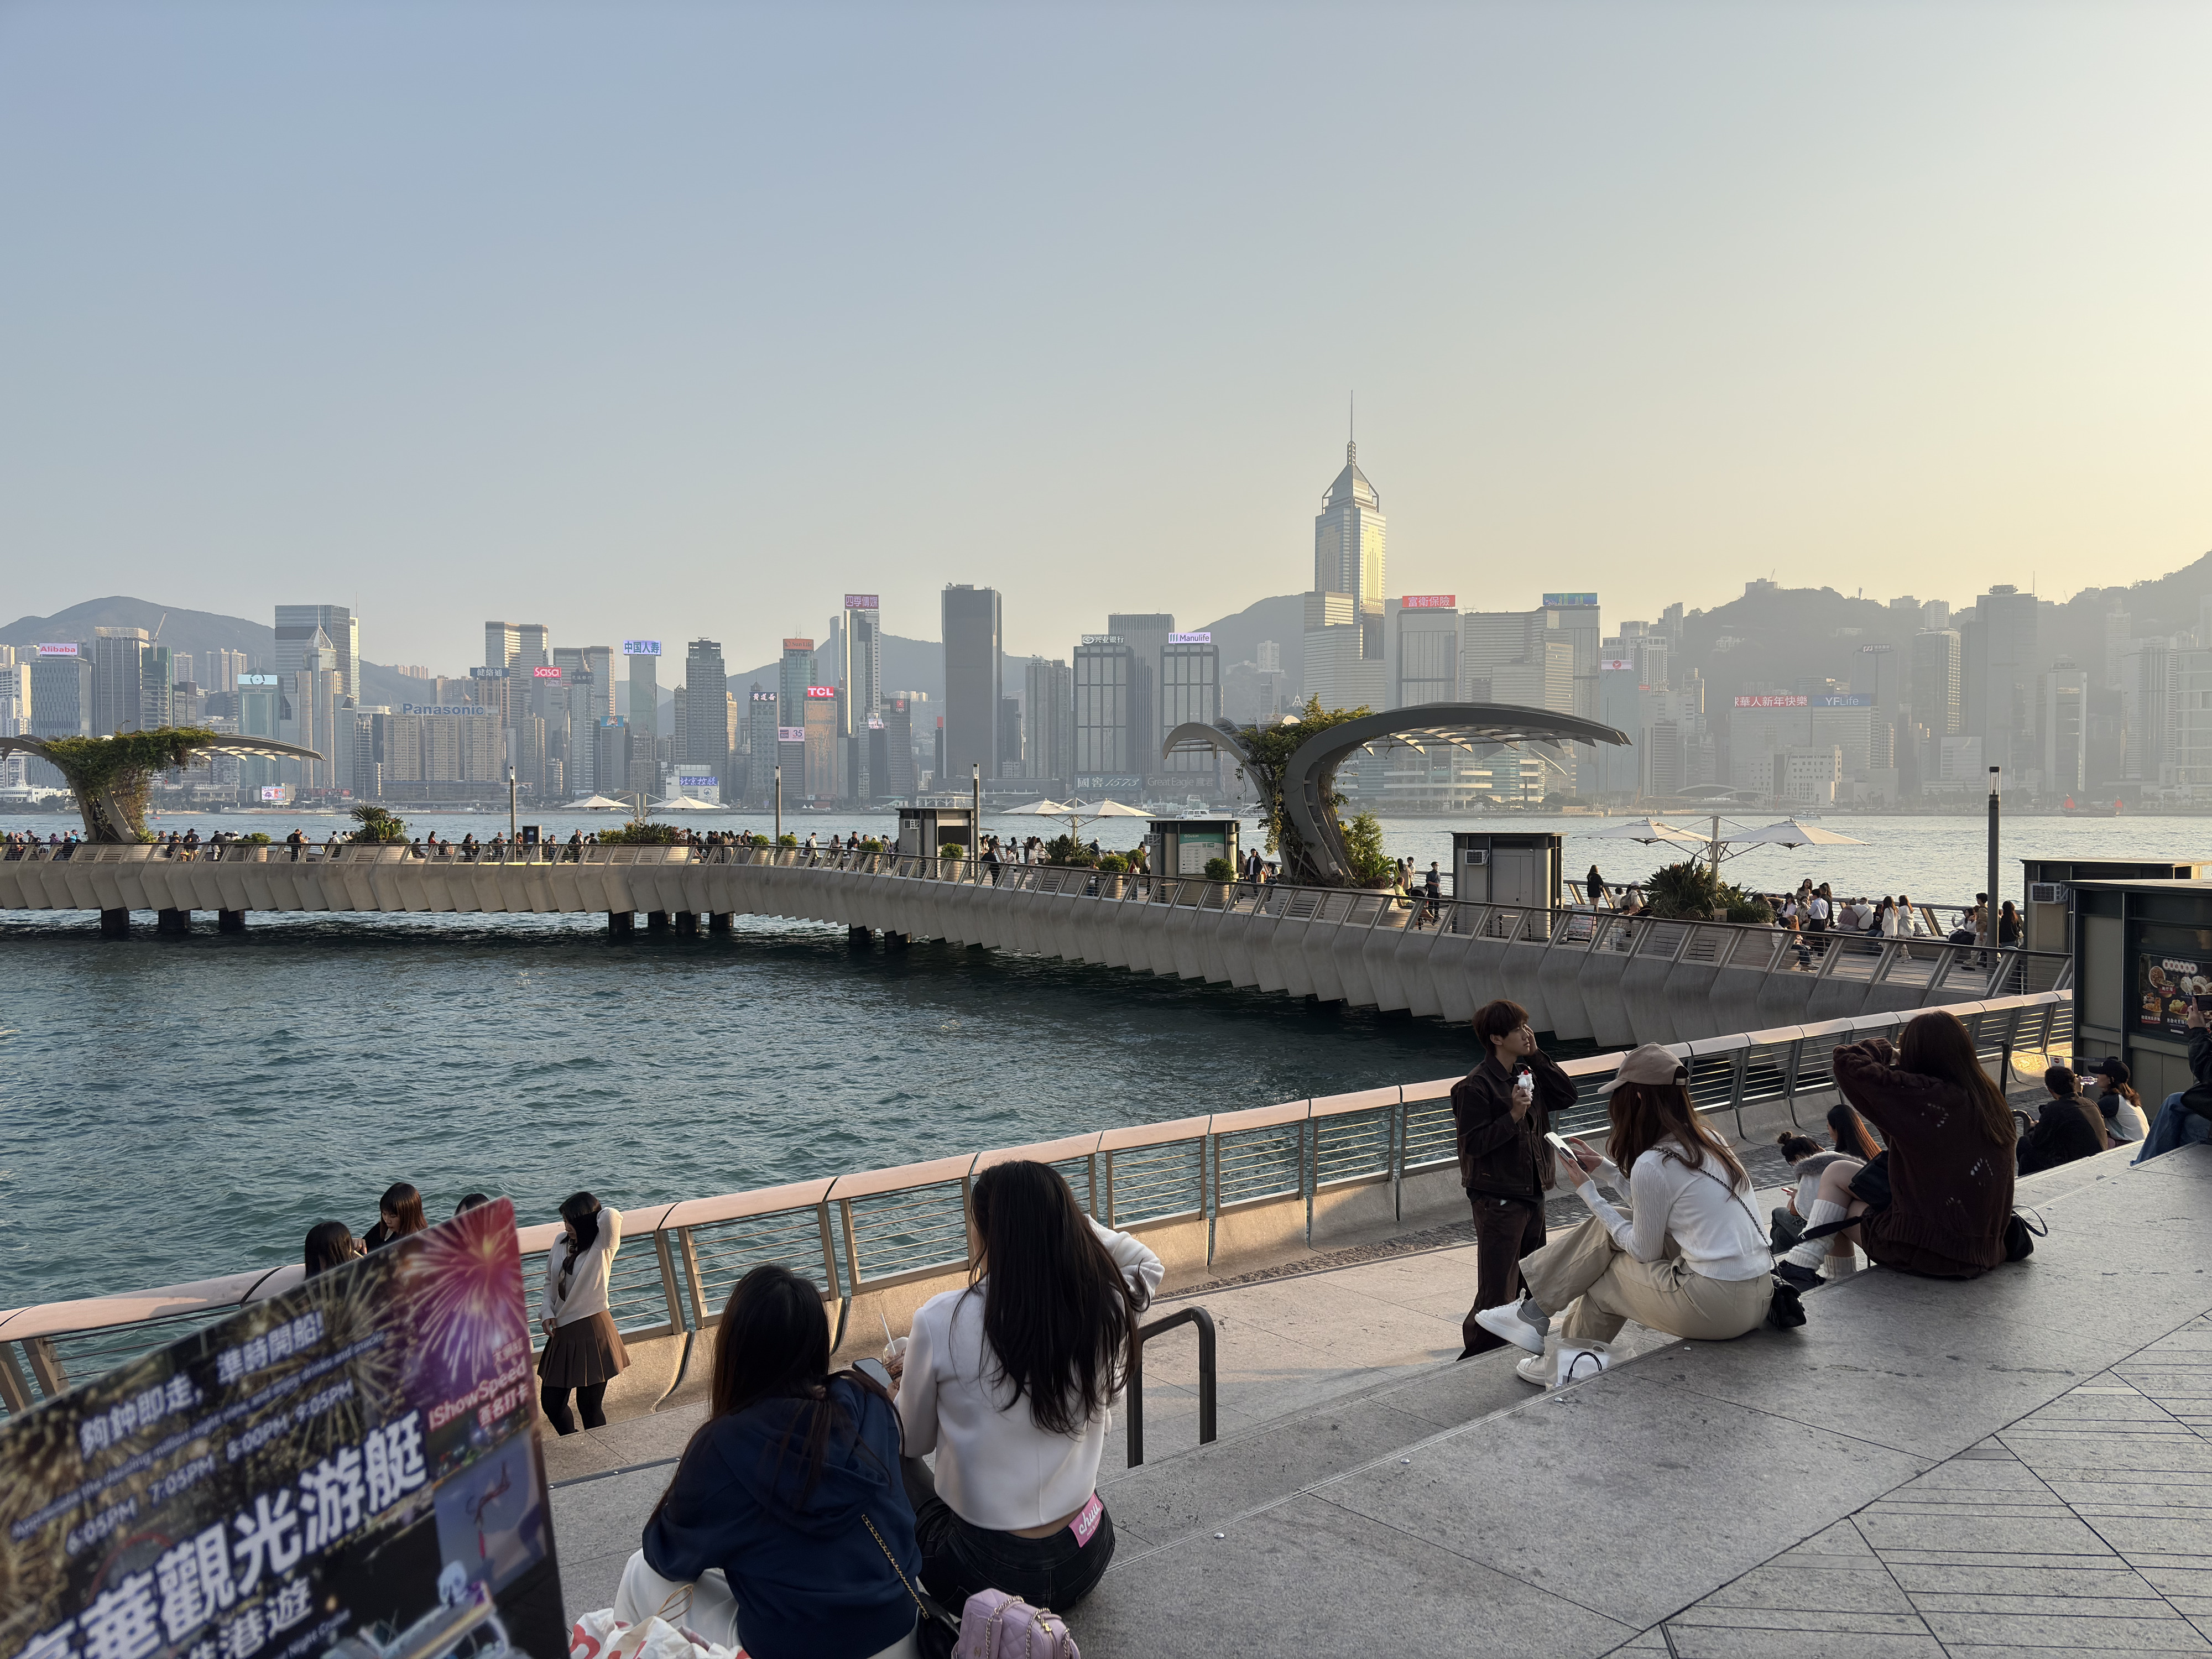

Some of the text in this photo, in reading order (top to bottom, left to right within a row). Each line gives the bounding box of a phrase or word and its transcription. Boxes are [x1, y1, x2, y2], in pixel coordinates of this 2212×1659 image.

[846, 596, 878, 607] 四季傳媒
[1408, 596, 1451, 607] 富衛保險
[1094, 635, 1124, 644] 兴业银行
[1179, 634, 1209, 642] Manulife
[624, 641, 660, 654] 中国人寿
[807, 687, 833, 696] TCL
[402, 703, 485, 715] Panasonic
[1147, 777, 1215, 789] Great Eagle 鷹君
[147, 1452, 216, 1509] 7:05PM
[226, 1412, 290, 1463] 8:00PM
[294, 1376, 356, 1423] 9:05PM
[1078, 1503, 1101, 1535] chuu
